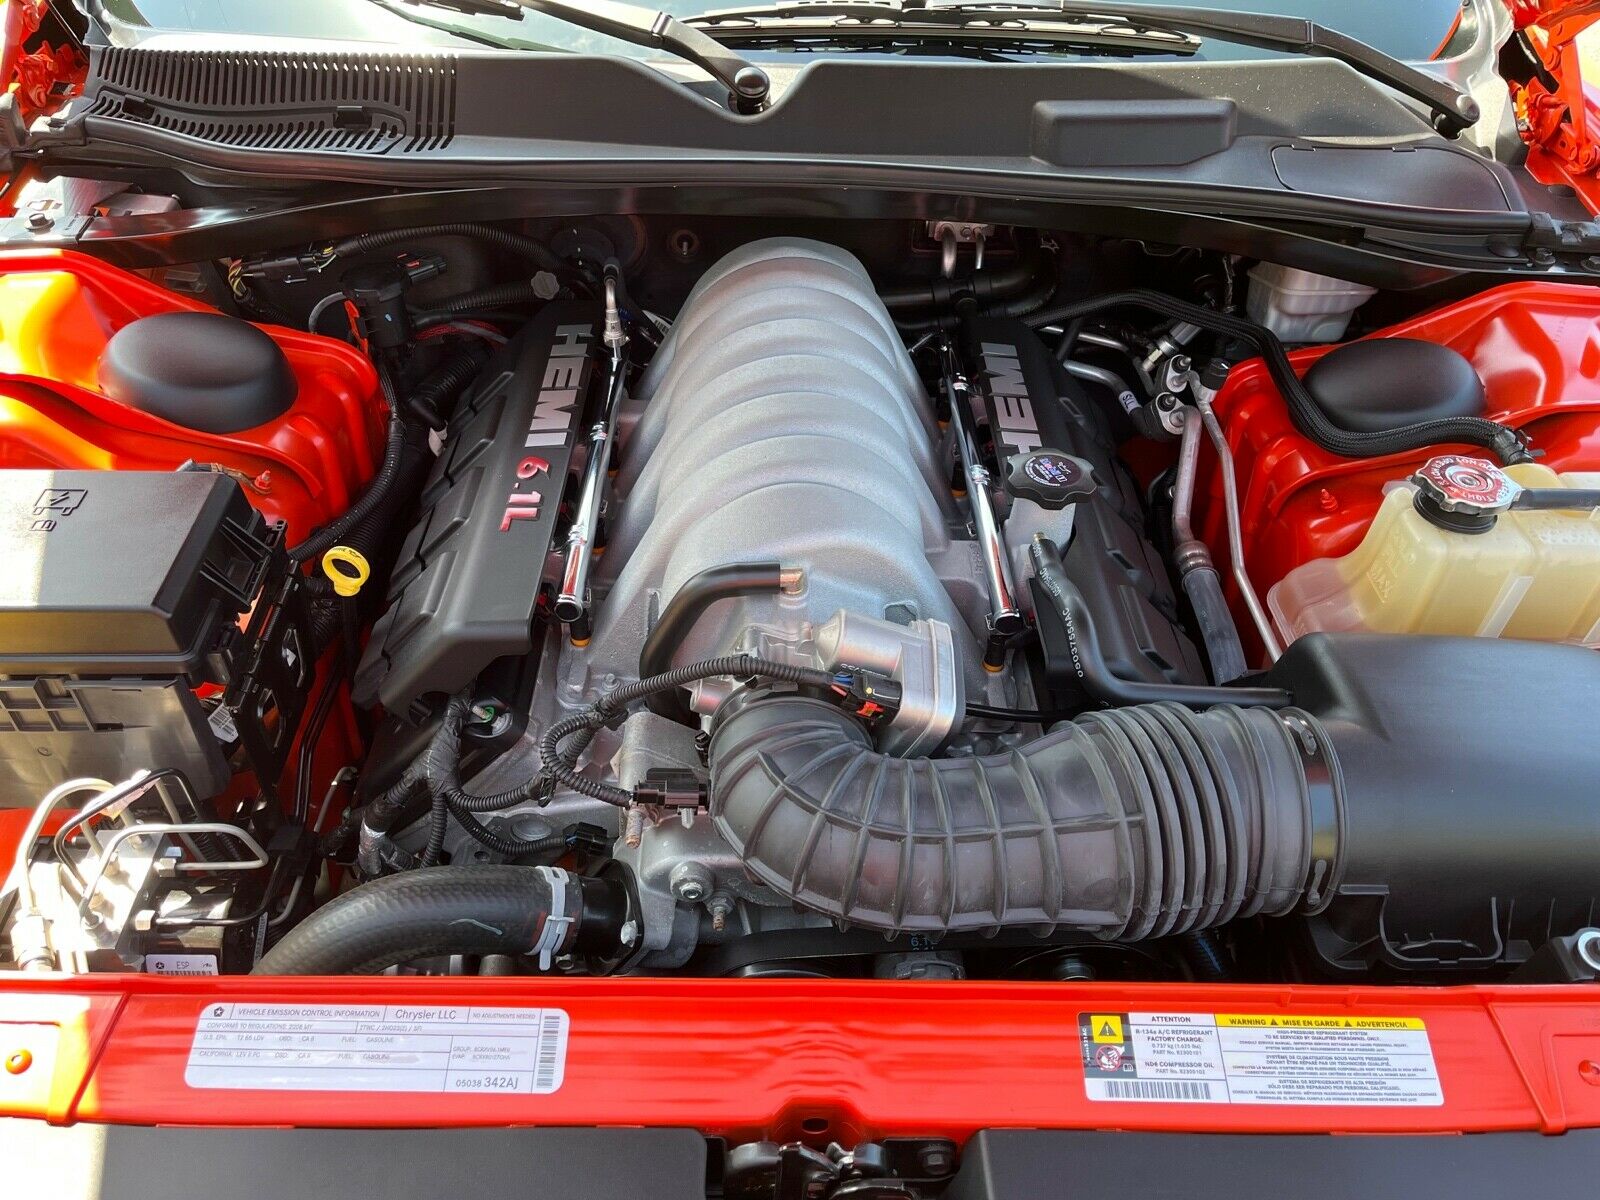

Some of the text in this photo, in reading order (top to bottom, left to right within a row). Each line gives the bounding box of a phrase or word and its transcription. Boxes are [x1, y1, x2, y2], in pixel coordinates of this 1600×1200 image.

[525, 324, 593, 447] HEMI
[499, 456, 550, 532] 6.1L
[176, 961, 190, 970] ESP
[395, 1009, 457, 1021] Chrysler LLC
[456, 1076, 518, 1090] 05038 342AJ
